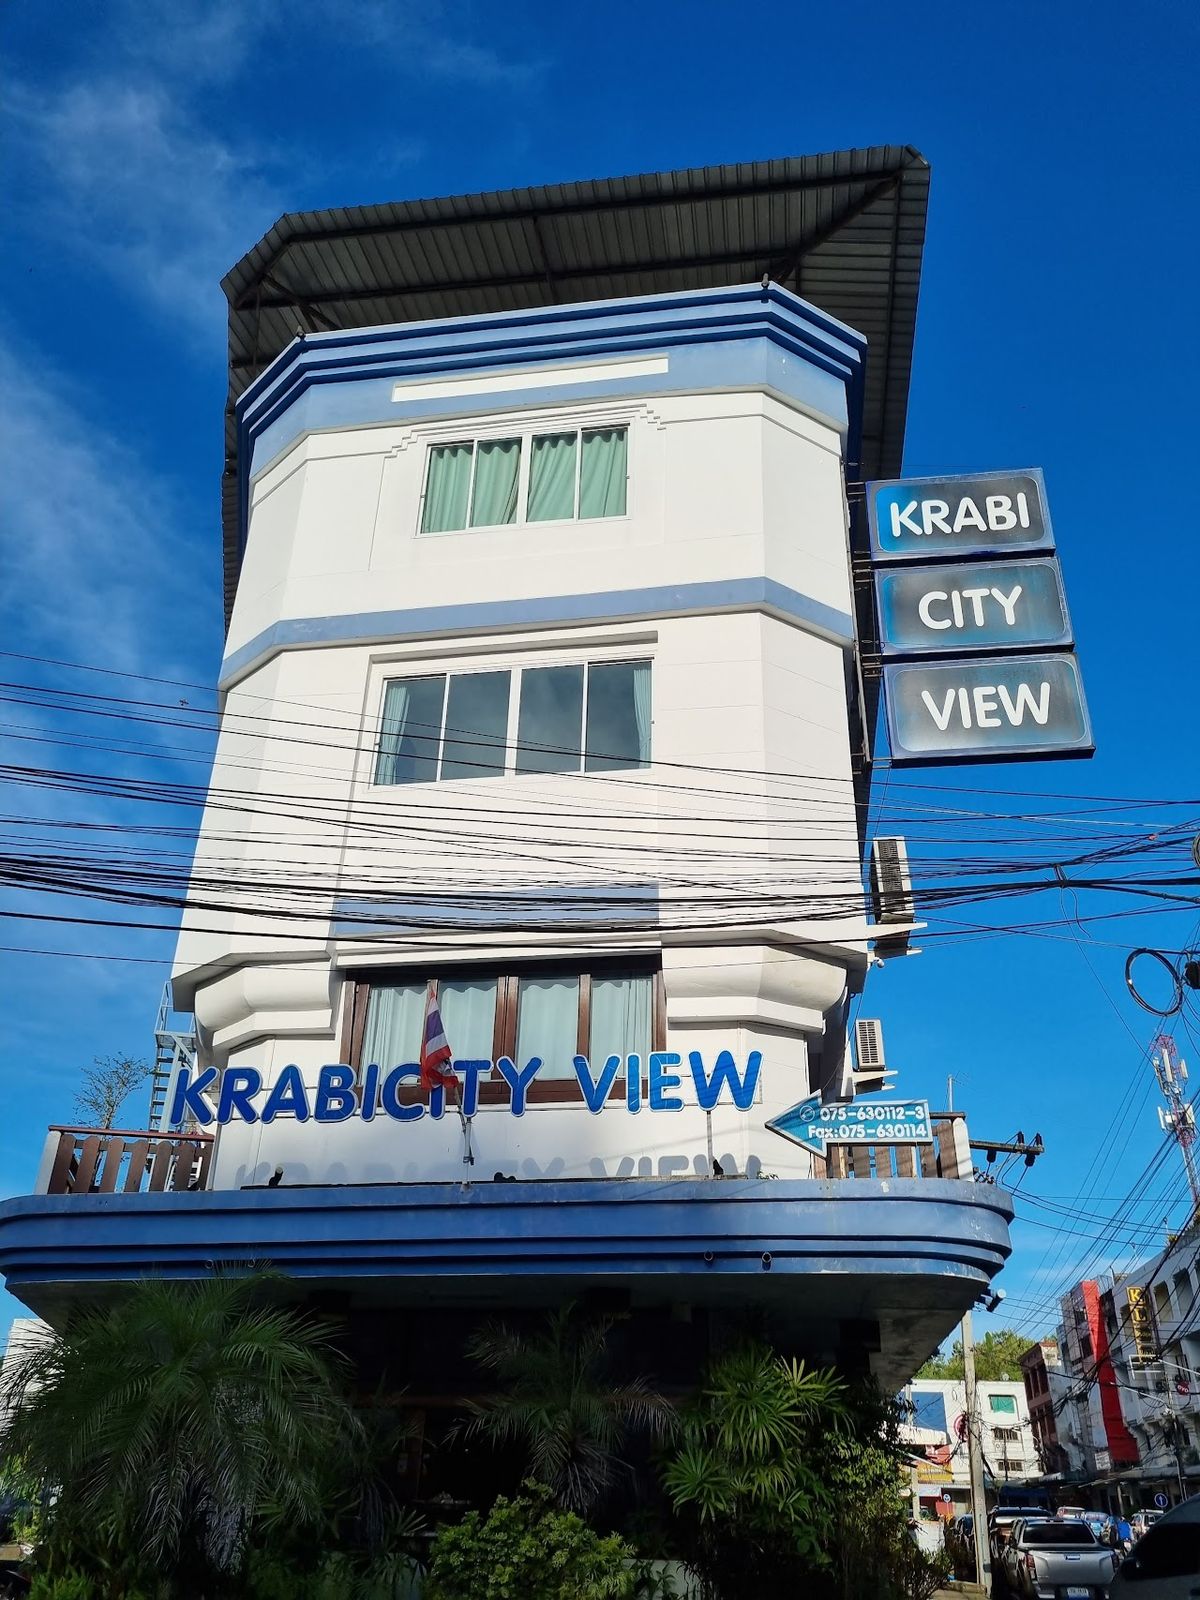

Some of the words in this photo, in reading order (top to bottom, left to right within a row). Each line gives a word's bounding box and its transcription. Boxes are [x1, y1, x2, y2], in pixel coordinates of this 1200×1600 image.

[890, 492, 1030, 537] KRABI
[918, 585, 1023, 629] CITY
[921, 681, 1050, 730] VIEW
[572, 1050, 763, 1115] VIEW
[820, 1106, 925, 1121] 075-630112-3
